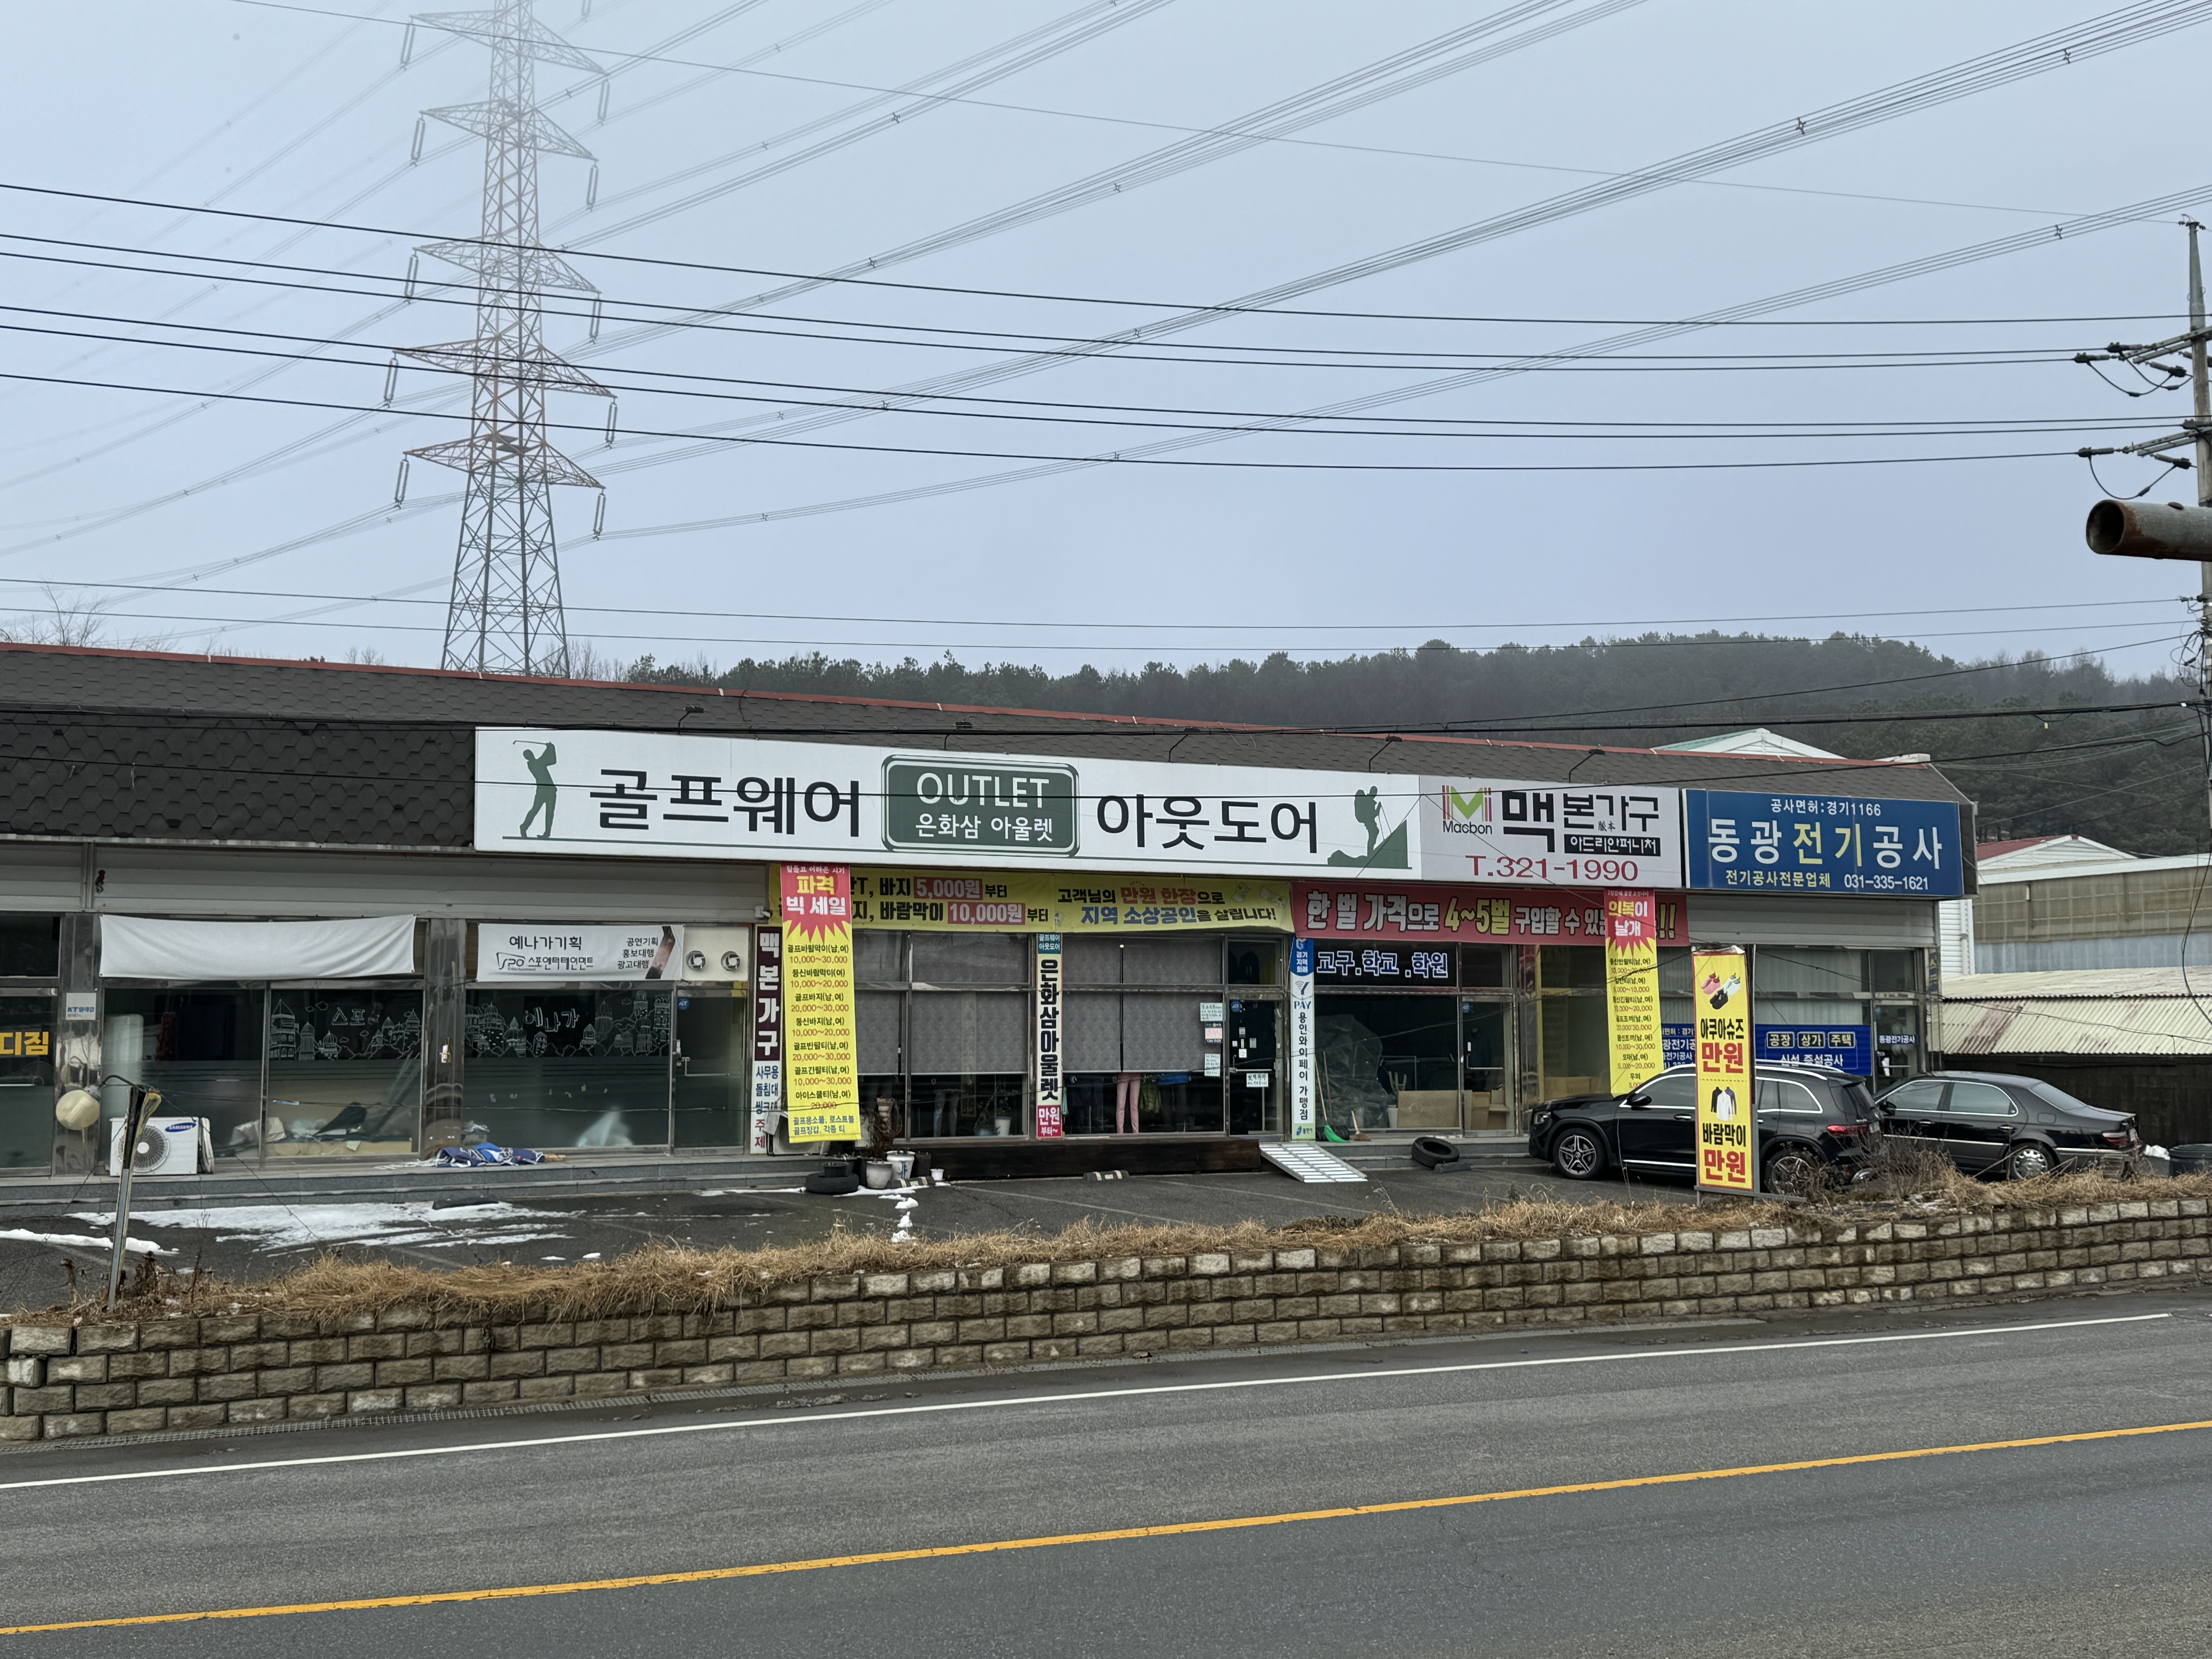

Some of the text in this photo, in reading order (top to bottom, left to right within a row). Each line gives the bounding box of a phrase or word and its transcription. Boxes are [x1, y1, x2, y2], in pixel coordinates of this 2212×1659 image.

[917, 773, 1049, 808] OUTLET
[590, 769, 859, 837] 골프웨어
[916, 813, 1053, 842] 은화삼 아울렛
[1097, 794, 1317, 854] 아웃도어
[1443, 821, 1492, 834] Macbon
[1502, 791, 1659, 852] 맥본가구
[1570, 837, 1657, 854] 아드리안퍼니처
[1708, 818, 1942, 869] 동광전기공사
[1465, 855, 1638, 881] T.321-1990
[797, 875, 835, 895] 파격
[1726, 870, 1831, 888] 전기공사전문업체
[1844, 874, 1929, 890] 031-335-1621
[879, 878, 911, 896] 바지
[917, 879, 980, 899] 5,000원
[985, 884, 1007, 898] 부터
[1058, 887, 1225, 905] 고객님의 만원 한장으로
[787, 896, 804, 915] 빅
[810, 896, 846, 915] 세일
[880, 902, 943, 922] 바람막이
[950, 903, 1022, 924] 10,000원
[1027, 908, 1048, 922] 부터
[1307, 890, 1331, 930] 한
[1336, 893, 1357, 930] 벌
[1363, 893, 1439, 931] 가격으로
[1444, 898, 1510, 934] 4~5벌
[1515, 907, 1562, 935] 구입할
[1565, 908, 1580, 935] 수
[1609, 901, 1648, 917] 의복이
[1081, 906, 1277, 925] 지역 소상공인을 살립니다!
[1615, 920, 1641, 936] 날개
[509, 936, 582, 950] 예나가기획
[627, 937, 659, 946] 공연기획
[622, 949, 654, 958] 홍보대행
[527, 957, 593, 970] 스포엔터테인먼트
[617, 960, 649, 969] 광고대행
[757, 933, 779, 1056] 맥본가구
[791, 1004, 849, 1012] 20,000~30,000
[1294, 1001, 1311, 1009] PAY
[331, 1007, 366, 1025] 스포
[792, 1029, 850, 1037] 10,000~20,000
[1040, 959, 1059, 1100] 은화삼아울렛
[1700, 1018, 1744, 1040] 아쿠아슈즈
[1769, 1034, 1851, 1046] 공장 상가 주택
[1879, 1035, 1915, 1044] 동광전기공사
[793, 1053, 850, 1061] 20,000~30,000
[1298, 1012, 1308, 1120] 용인와이페이 가맹점
[1702, 1042, 1743, 1073] 만원
[756, 1065, 779, 1079] 사무용
[756, 1083, 778, 1097] 돌침대
[794, 1077, 852, 1086] 10,000~30,000
[1039, 1107, 1060, 1125] 만원
[1702, 1123, 1746, 1147] 바람막이
[1704, 1149, 1746, 1183] 만원
